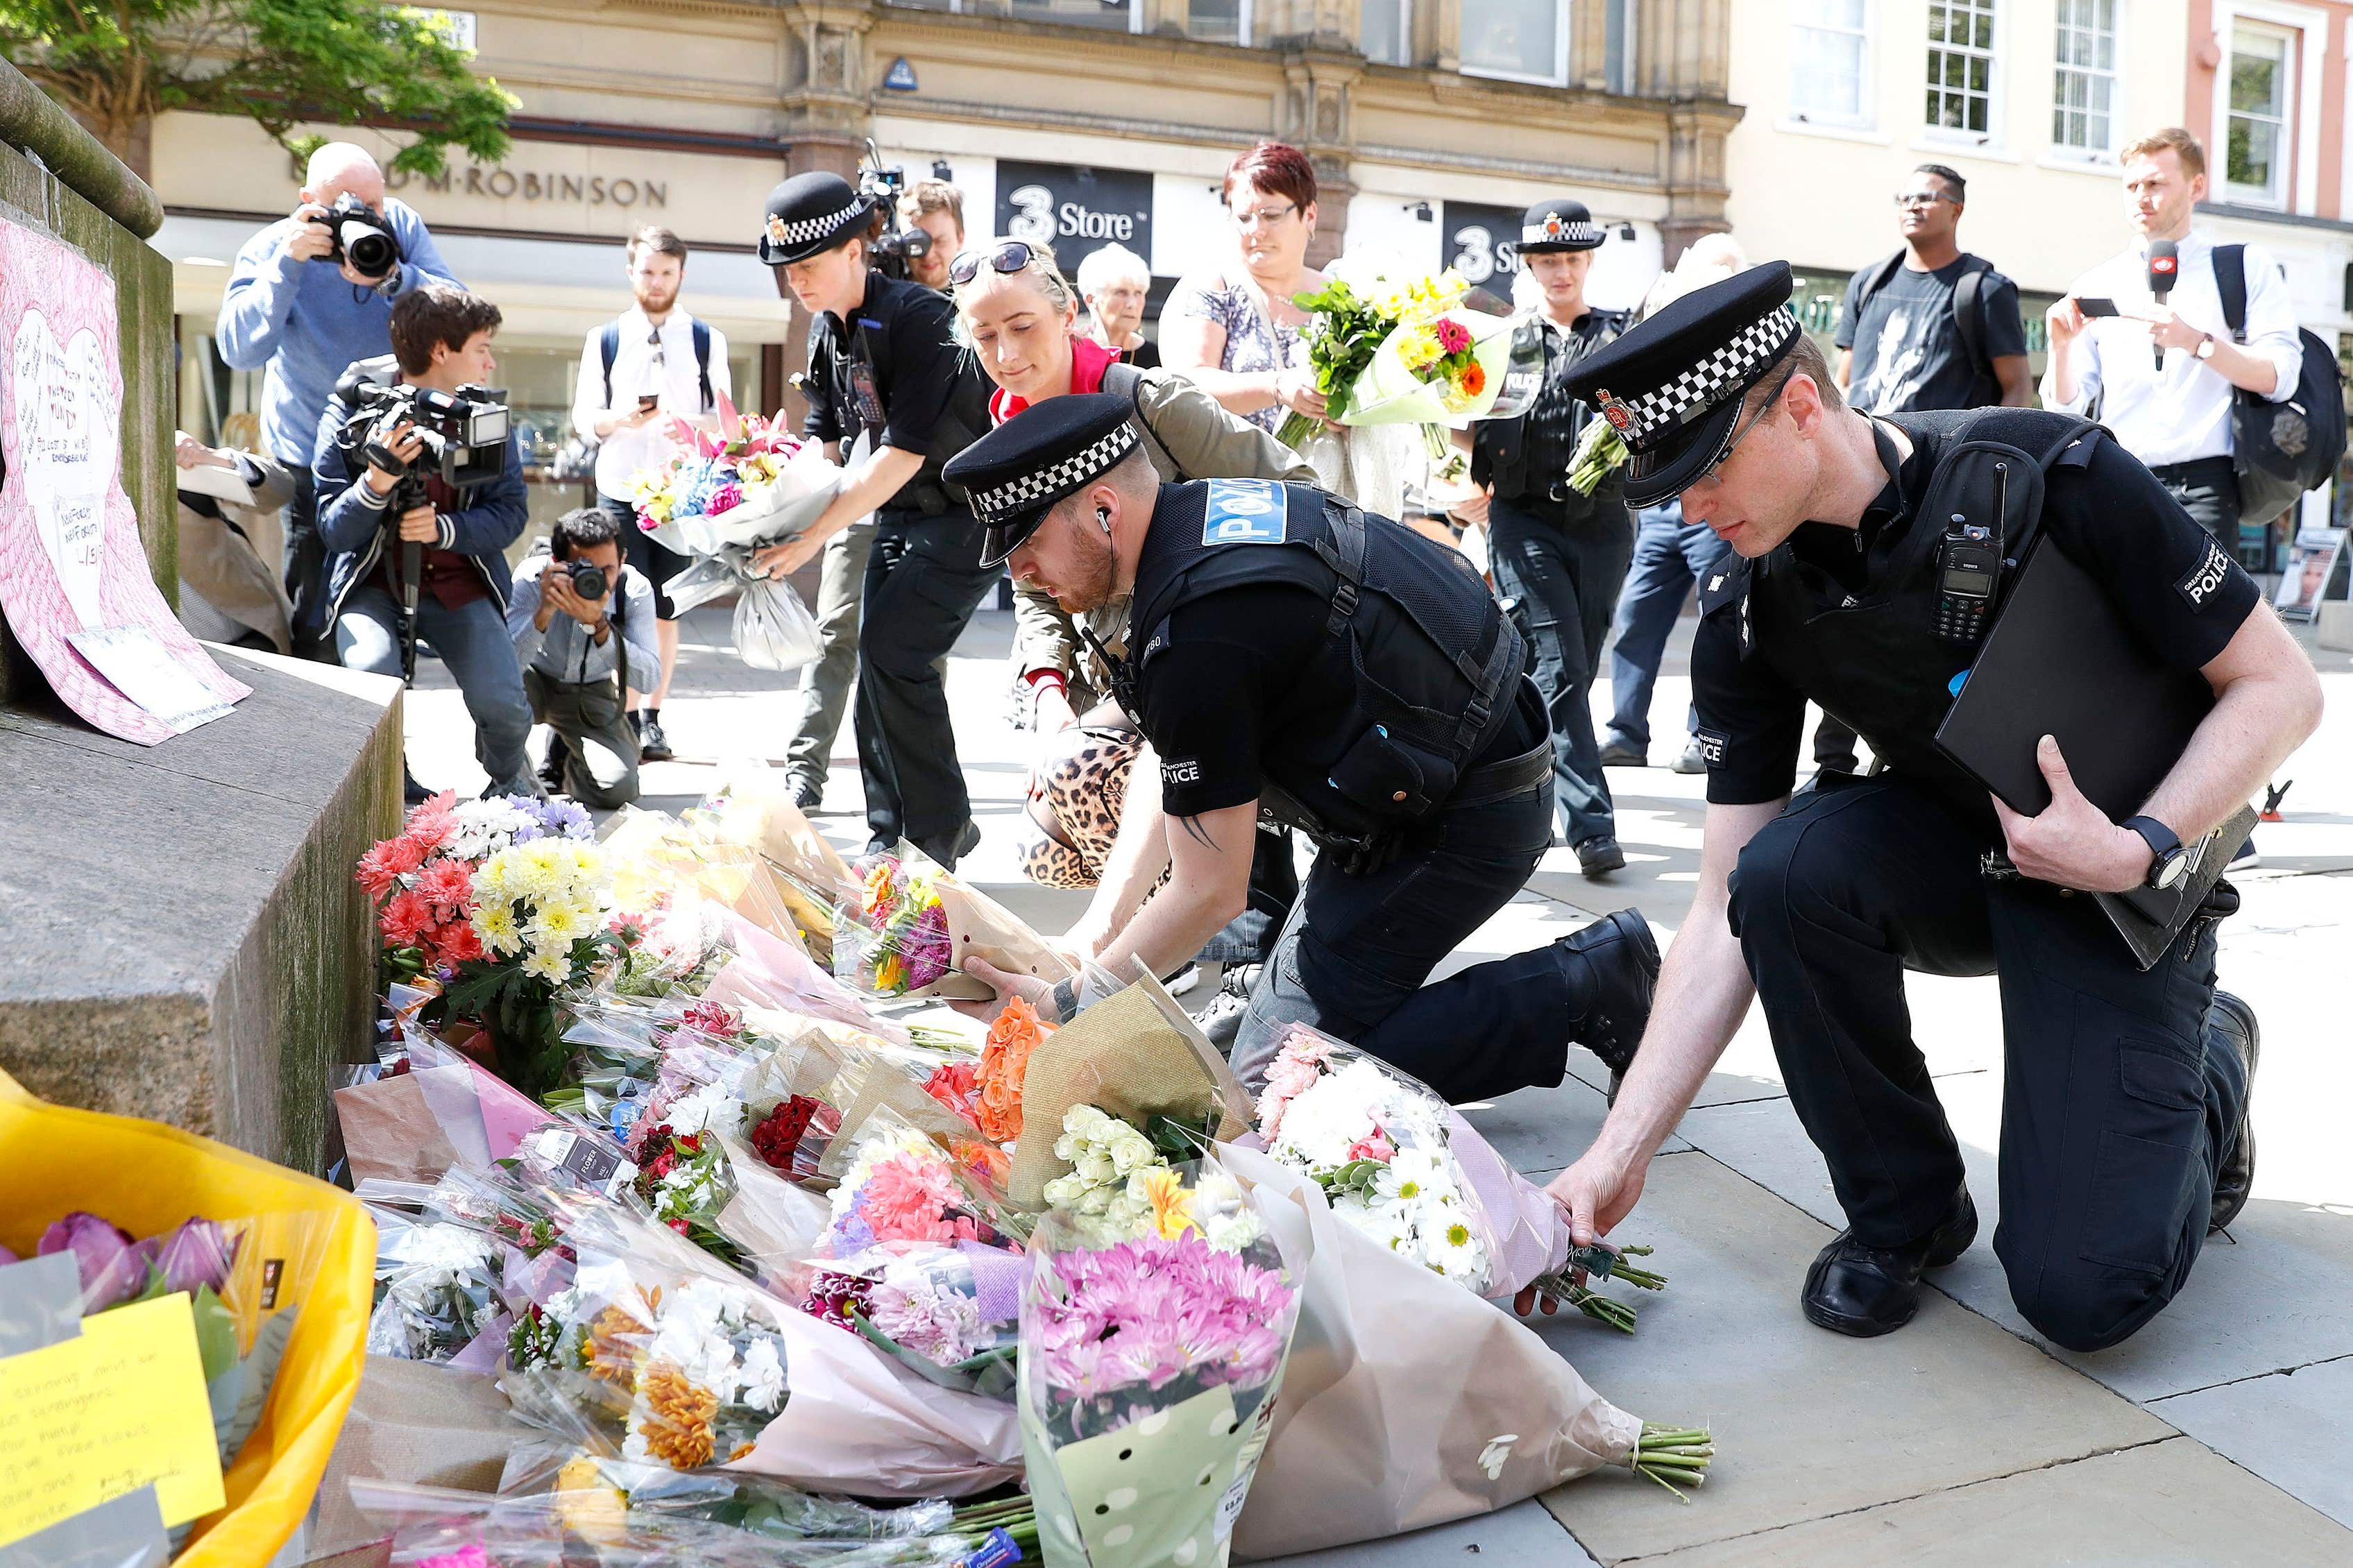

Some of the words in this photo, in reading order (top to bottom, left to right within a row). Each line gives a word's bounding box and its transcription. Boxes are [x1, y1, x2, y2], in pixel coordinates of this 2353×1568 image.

[466, 166, 668, 209] ROBINSON
[1008, 184, 1057, 244] 3
[1057, 202, 1133, 241] Store
[1453, 225, 1495, 284] 3
[2184, 568, 2207, 591] GREATER
[2189, 548, 2229, 604] POLICE
[581, 1149, 597, 1174] FLOWER
